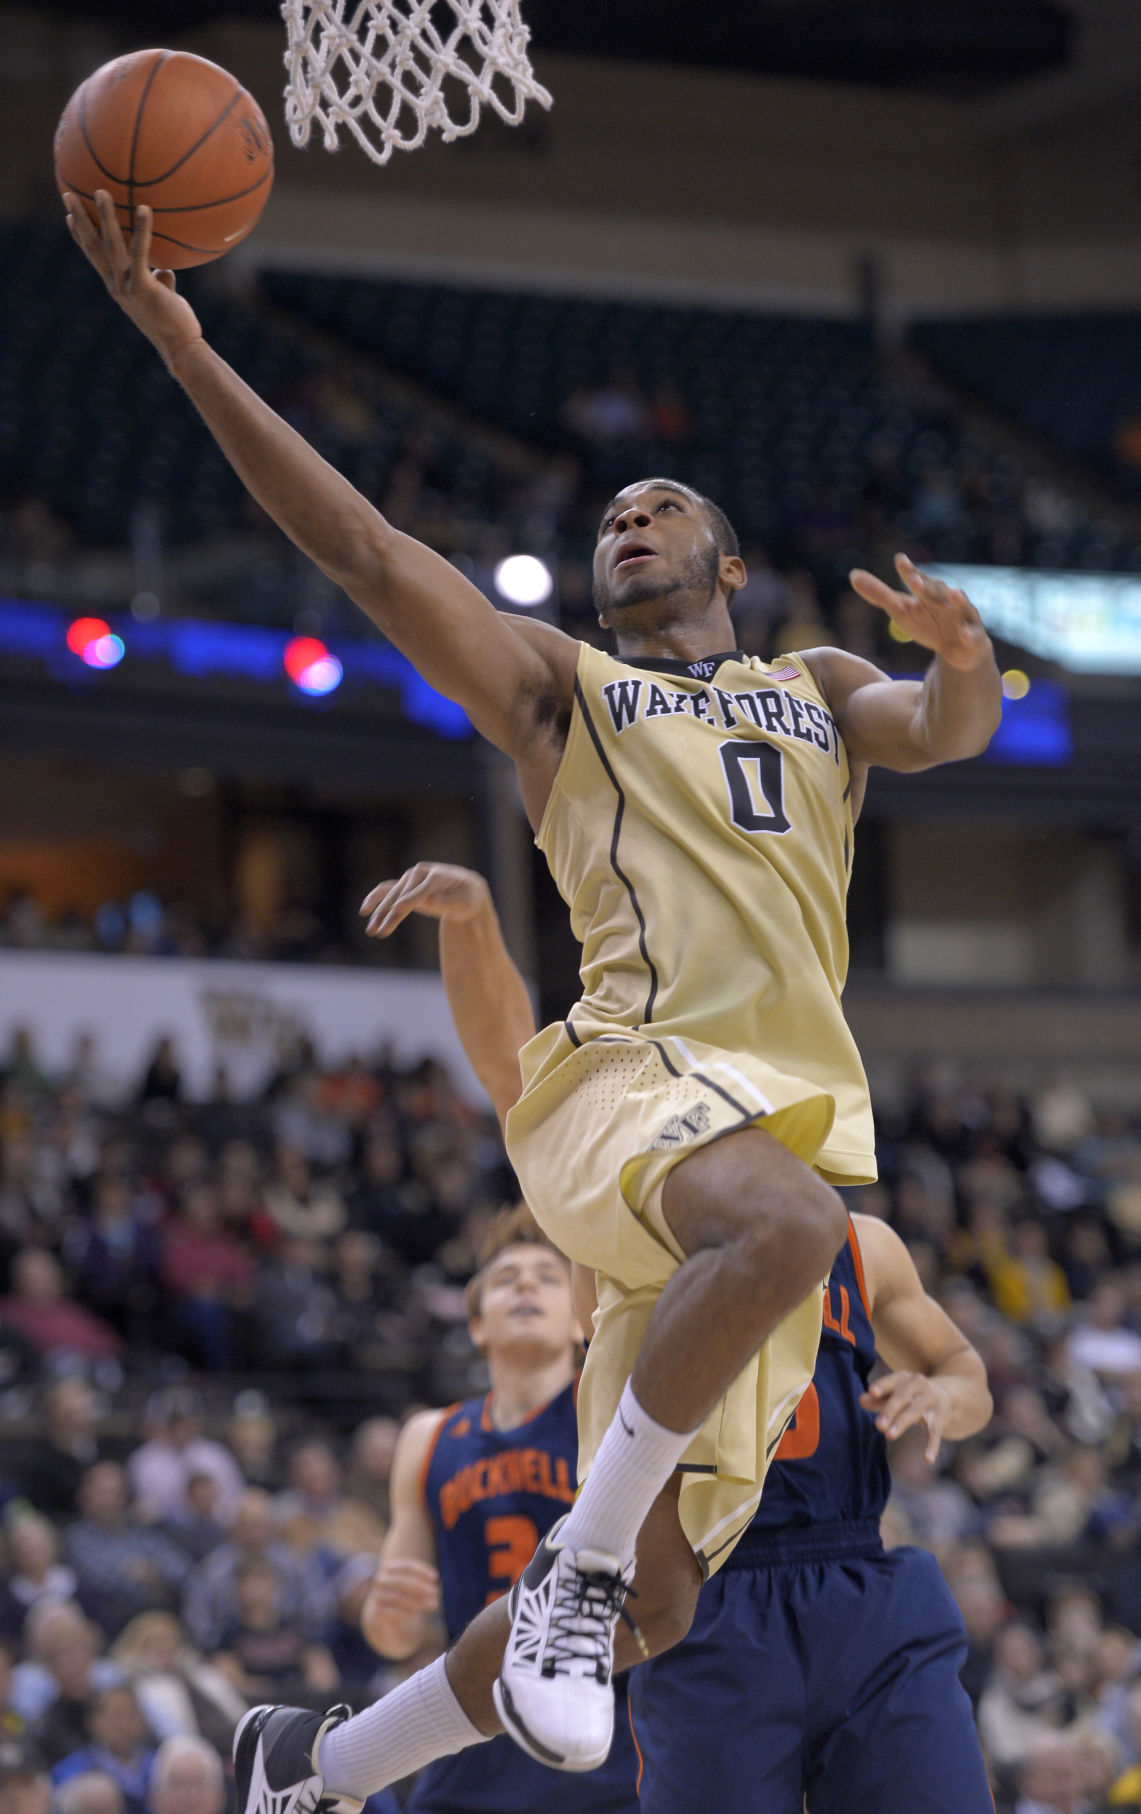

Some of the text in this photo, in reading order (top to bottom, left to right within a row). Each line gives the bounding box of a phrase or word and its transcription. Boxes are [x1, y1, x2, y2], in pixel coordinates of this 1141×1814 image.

[687, 661, 715, 678] WF
[717, 739, 793, 835] 0
[484, 1514, 539, 1606] 3
